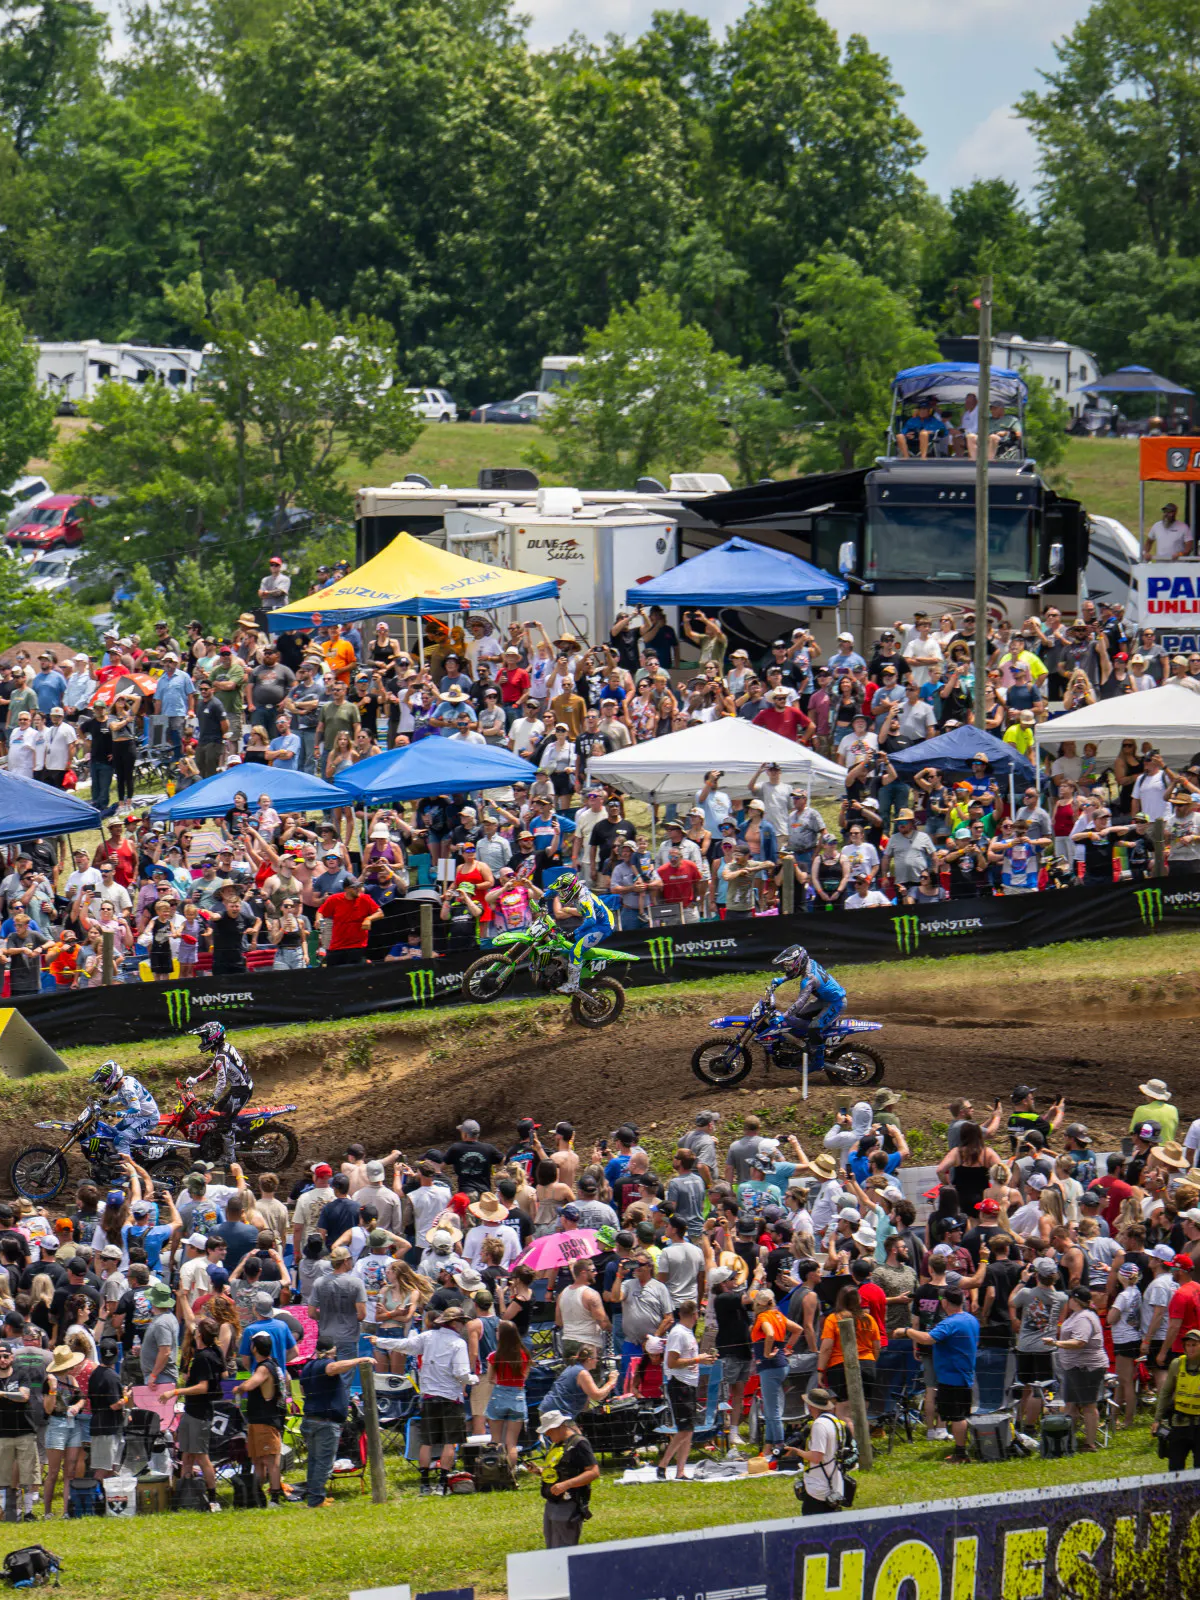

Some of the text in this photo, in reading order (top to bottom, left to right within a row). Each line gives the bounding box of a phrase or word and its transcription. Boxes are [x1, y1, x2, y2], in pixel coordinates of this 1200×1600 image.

[527, 539, 559, 549] DUNE
[547, 548, 585, 561] Seeker
[440, 571, 502, 593] SUZUKI
[1147, 576, 1200, 598] PA
[335, 586, 400, 600] SUZUKI
[1161, 634, 1200, 653] PA
[1163, 892, 1200, 904] MONS
[920, 917, 983, 932] MONSTER
[930, 929, 974, 938] ENERGY
[675, 938, 737, 952] MONSTER
[685, 949, 729, 958] ENERGY
[590, 959, 607, 973] 141
[192, 991, 254, 1006] MONSTER
[202, 1004, 245, 1012] ENERGY
[825, 1035, 841, 1047] 42
[249, 1118, 265, 1131] 30
[148, 1146, 164, 1159] 99
[558, 1238, 586, 1252] IRON
[563, 1246, 589, 1260] PONY
[803, 1509, 1200, 1600] HOLESH
